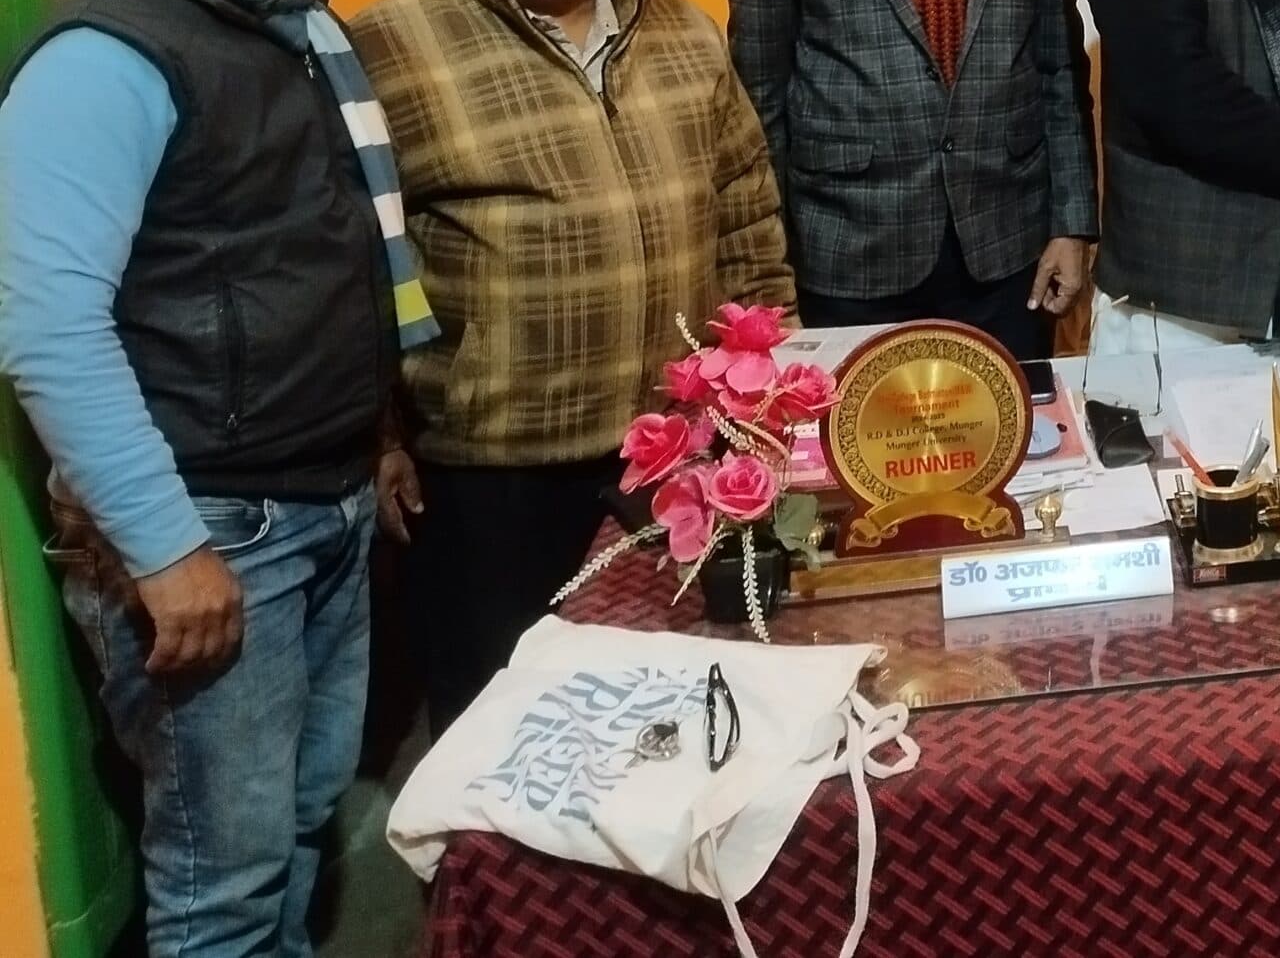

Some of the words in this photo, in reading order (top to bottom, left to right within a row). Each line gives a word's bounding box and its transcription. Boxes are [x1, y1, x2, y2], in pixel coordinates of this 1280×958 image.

[885, 429, 894, 439] &
[949, 420, 984, 432] Munger
[886, 440, 920, 451] Munger
[884, 450, 977, 479] RUNNER
